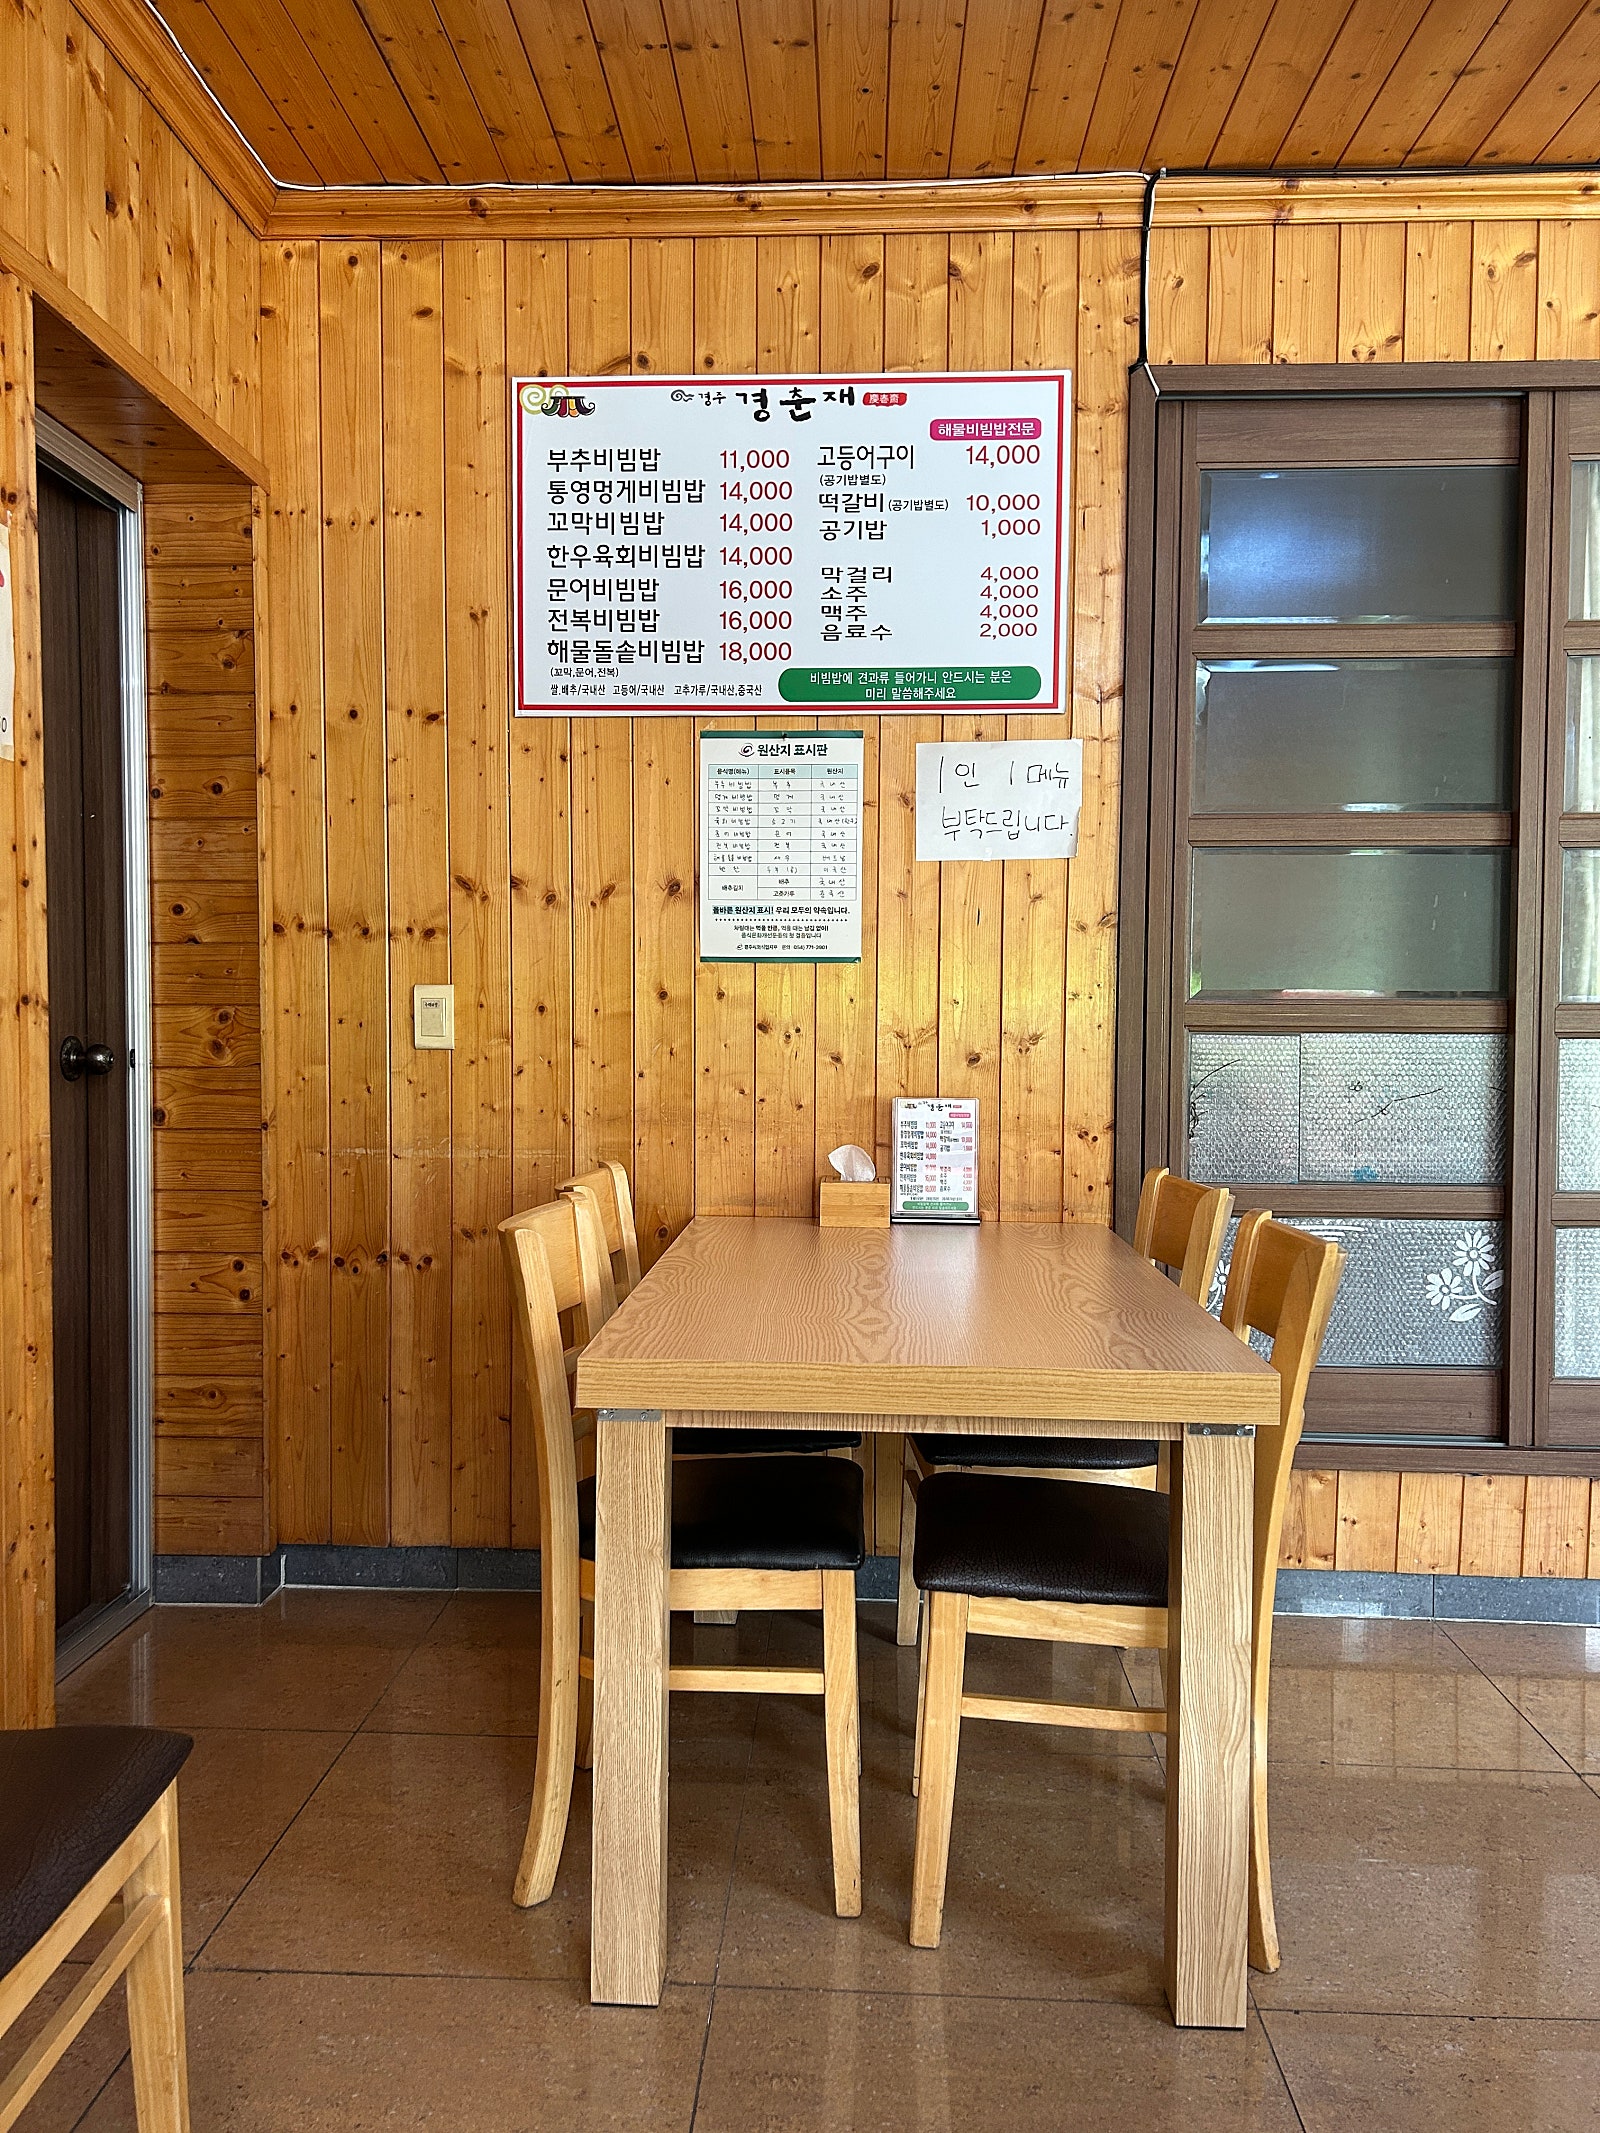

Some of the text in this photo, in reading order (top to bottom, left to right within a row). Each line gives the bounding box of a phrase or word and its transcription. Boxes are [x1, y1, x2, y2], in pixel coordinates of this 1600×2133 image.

[698, 391, 726, 406] 경주
[938, 423, 1035, 437] 해물비빔밥전문
[547, 449, 661, 472] 부추비빔밥
[719, 450, 790, 472] 11,000
[817, 445, 915, 470] 고등어구이
[966, 445, 1040, 468] 14,000
[819, 475, 886, 486] (공기밥별도)
[547, 480, 706, 504] 통영멍게비빔밥
[719, 481, 793, 504] 14,000
[819, 494, 949, 513] 떡갈비 (공기밥별도)
[966, 495, 1040, 514] 10,000
[547, 511, 665, 536] 꼬막비빔밥
[719, 513, 793, 535] 14,000
[819, 520, 887, 541] 공기밥
[982, 519, 1040, 539] 1,000
[547, 544, 706, 569] 한우육회비빔밥
[719, 546, 793, 569] 14,000
[821, 566, 893, 583] 막걸리
[980, 566, 1039, 583] 4,000
[547, 578, 659, 602] 문어비빔밥
[719, 580, 792, 603] 16,000
[821, 586, 867, 602] 소주
[980, 585, 1039, 601] 4,000
[548, 609, 660, 633] 전복비빔밥
[719, 610, 792, 634] 16,000
[821, 605, 867, 622] 맥주
[980, 604, 1038, 620] 4,000
[820, 624, 893, 641] 음료수
[979, 623, 1038, 640] 2,000
[547, 640, 705, 664] 해물돌솥비빔밥
[719, 642, 792, 664] 18,000
[550, 668, 619, 678] (꼬막,문어,전복)
[810, 670, 1012, 685] 비빔밥에 견과류 들어가니 안드시는 분은
[865, 687, 956, 700] 미리 말씀해주세요
[758, 744, 828, 756] 원산지 표시판
